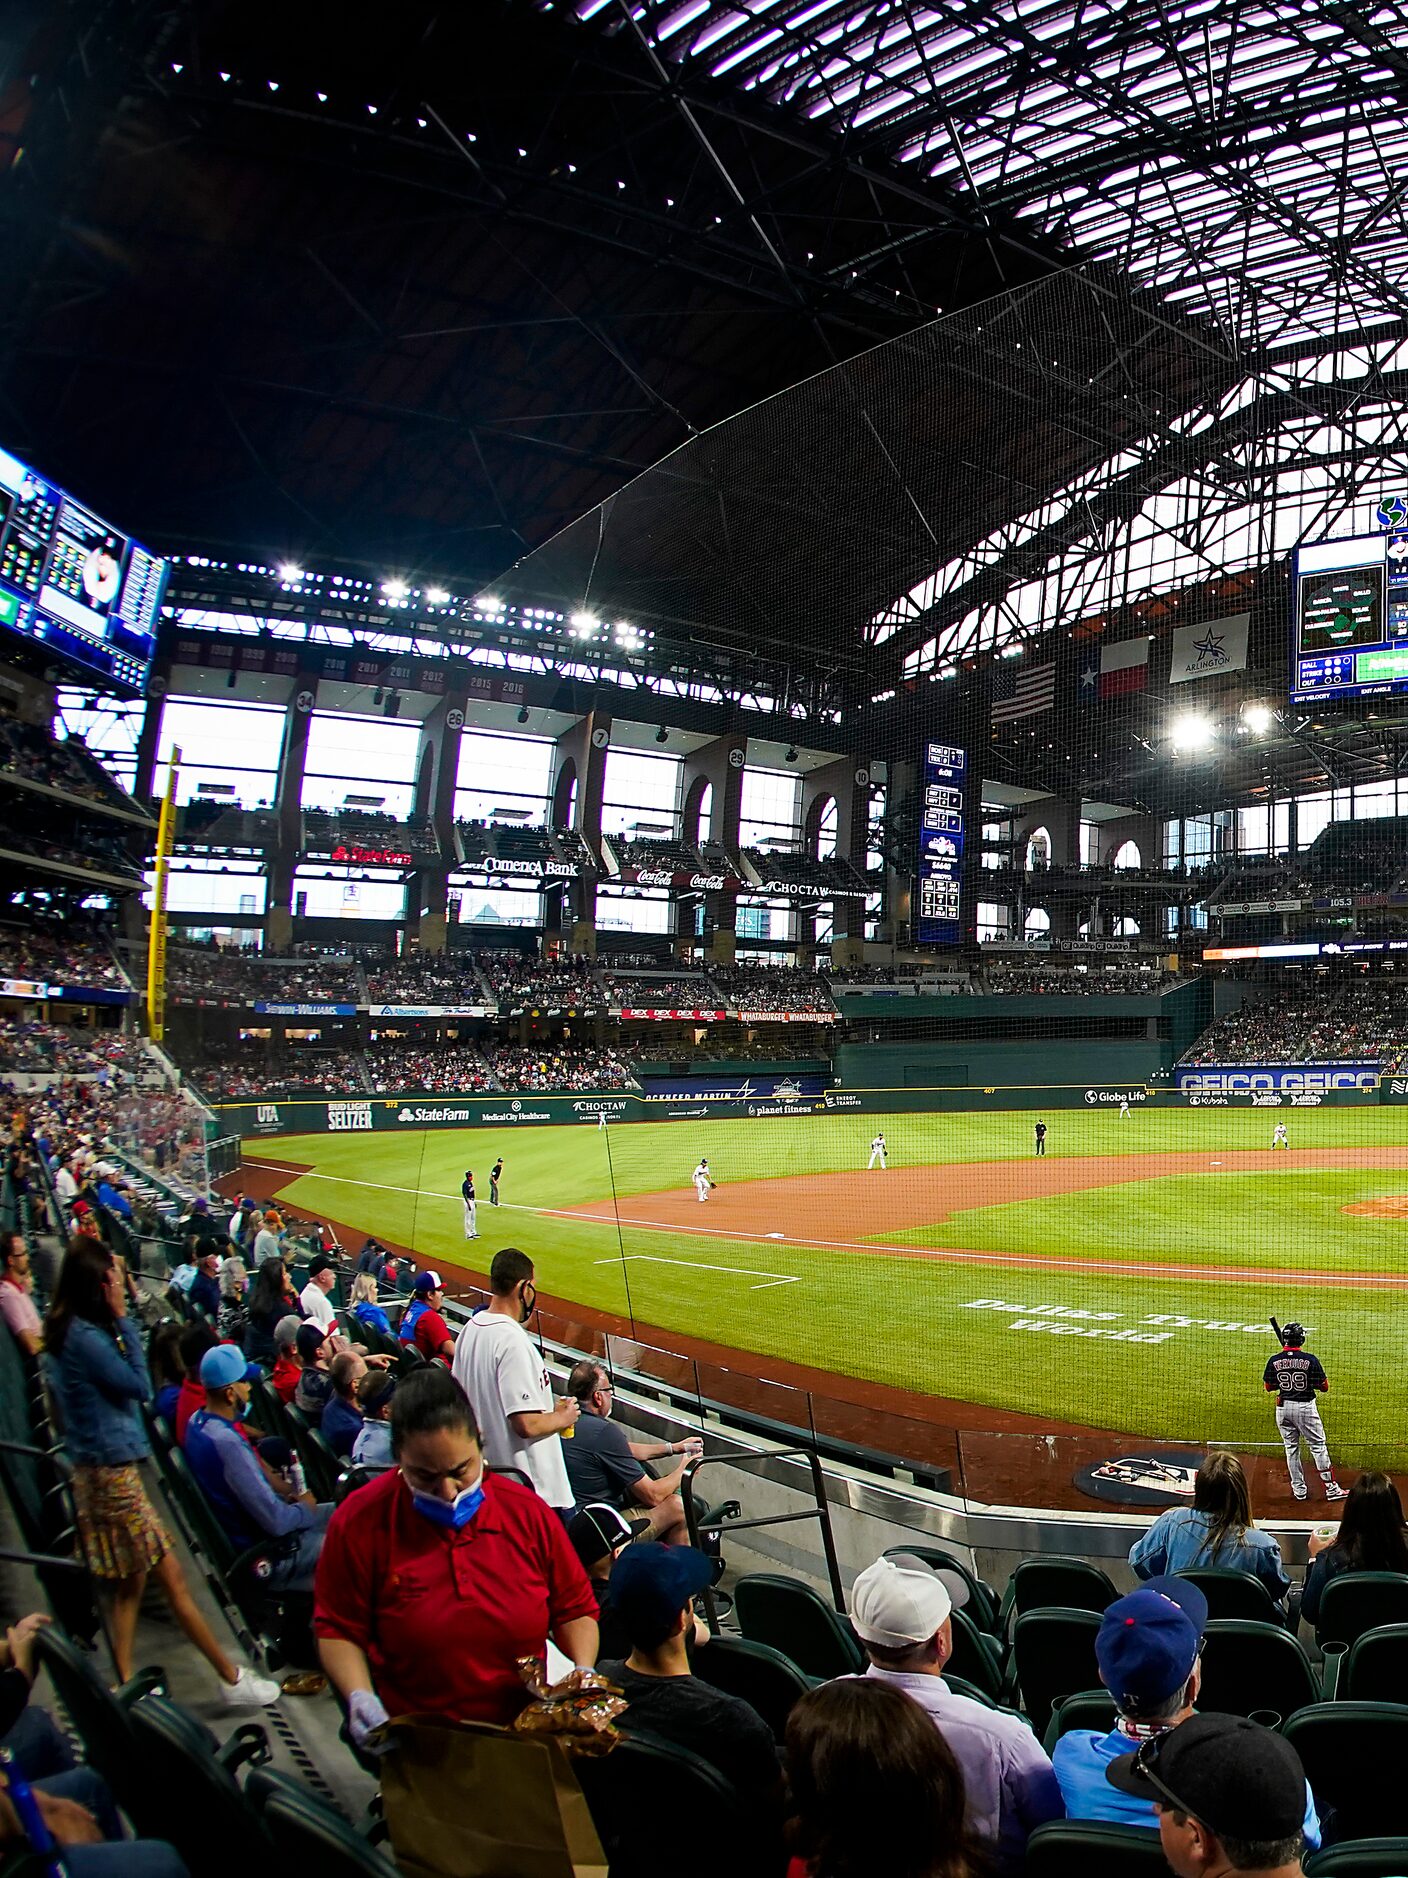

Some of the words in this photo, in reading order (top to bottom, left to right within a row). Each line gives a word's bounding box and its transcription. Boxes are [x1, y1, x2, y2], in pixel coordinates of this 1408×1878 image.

[358, 662, 379, 674] 2011
[1185, 656, 1231, 673] ARLINGTON
[1302, 661, 1317, 669] BALL
[390, 666, 411, 678] 2011
[422, 670, 444, 683] 2012
[1302, 669, 1323, 677] STRIKE
[471, 677, 492, 690] 2015
[503, 681, 524, 694] 2016
[298, 695, 313, 709] 34
[1306, 692, 1330, 701] VELOCITY
[448, 713, 463, 725] 26
[597, 733, 605, 744] 7
[730, 753, 743, 765] 29
[856, 771, 868, 784] 10
[545, 862, 579, 877] Bank
[1330, 897, 1352, 907] 105.3
[394, 1007, 429, 1016] Albertsons
[740, 1011, 786, 1021] WHATABURGER
[788, 1012, 832, 1022] WHATABURGER
[1181, 1074, 1275, 1096] GEICO
[1280, 1072, 1380, 1095] GEICO
[1099, 1091, 1128, 1102] Globe
[1128, 1090, 1146, 1101] Life
[1202, 1096, 1228, 1105] Kubota
[328, 1103, 346, 1111] BUD
[346, 1102, 372, 1110] LIGHT
[578, 1101, 627, 1111] CHOCTAW
[757, 1105, 783, 1116] planet
[784, 1104, 812, 1114] fitness
[257, 1105, 279, 1122] UTA
[482, 1112, 506, 1121] Medical
[506, 1112, 518, 1122] City
[518, 1111, 550, 1120] Healthcare
[328, 1110, 373, 1130] SELTZER
[959, 1299, 1125, 1321] Dallas
[1138, 1313, 1318, 1334] Truc
[1007, 1319, 1175, 1344] World
[1273, 1358, 1311, 1371] VERDUGO
[1276, 1371, 1308, 1391] 99
